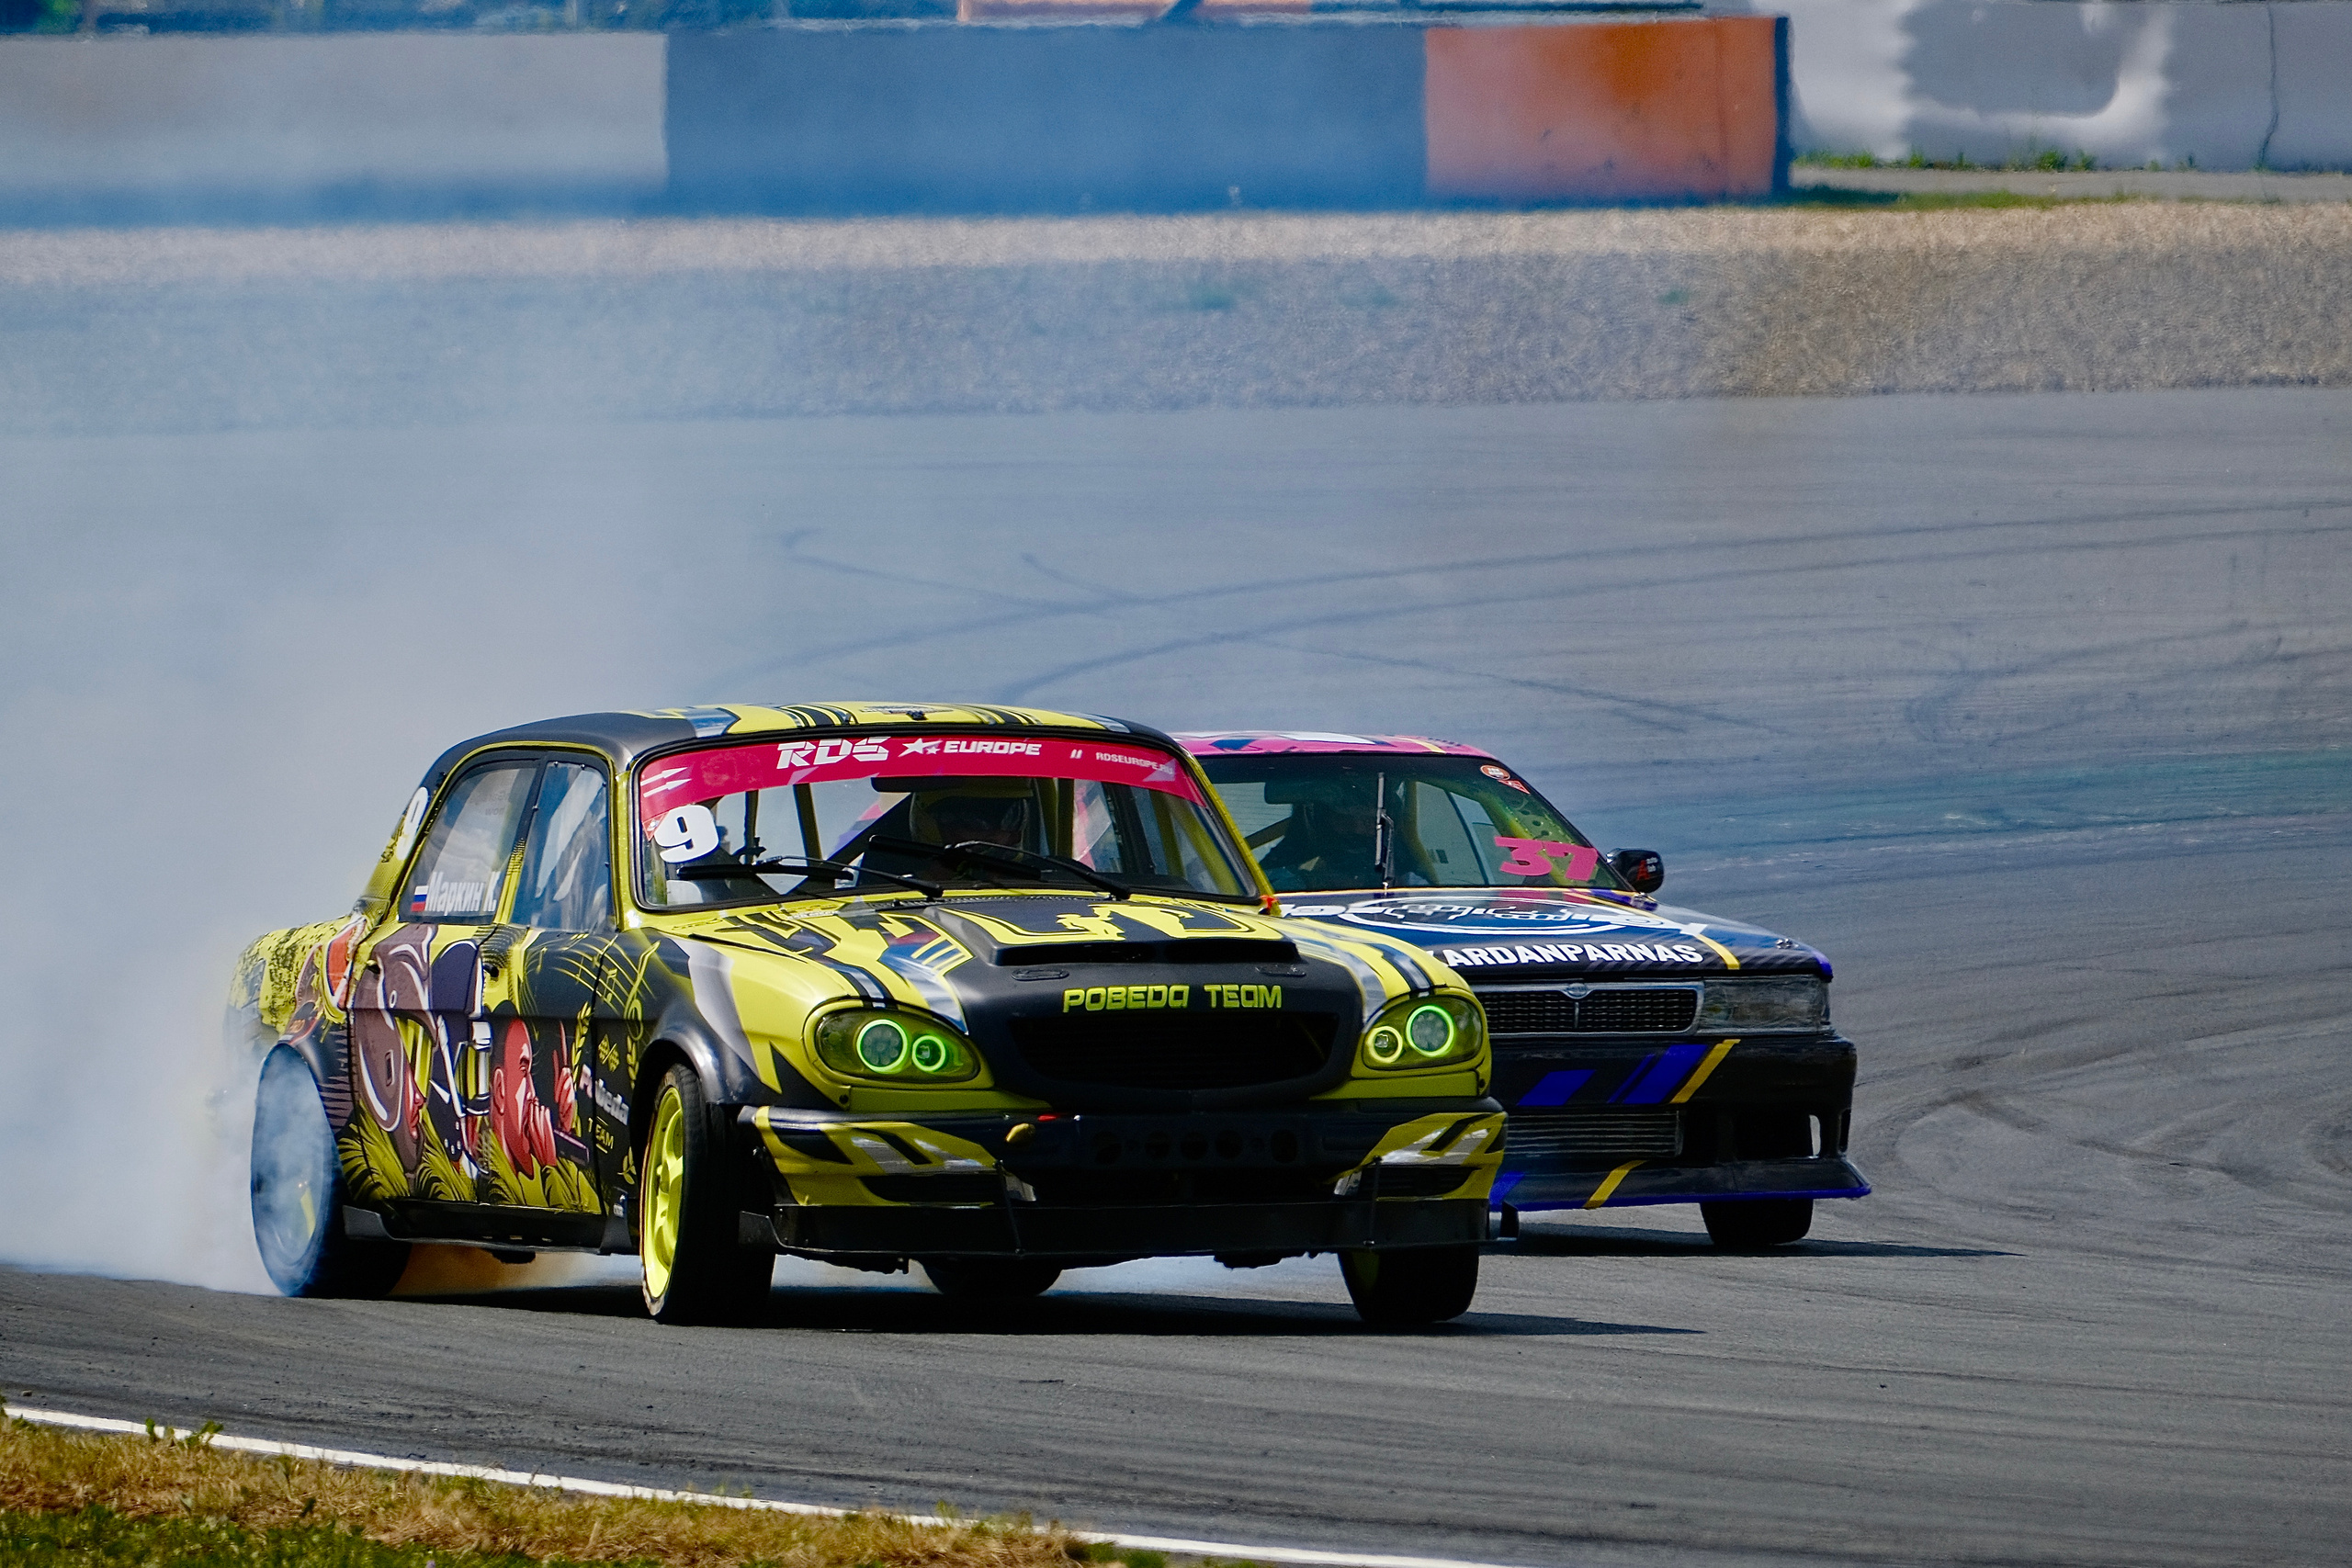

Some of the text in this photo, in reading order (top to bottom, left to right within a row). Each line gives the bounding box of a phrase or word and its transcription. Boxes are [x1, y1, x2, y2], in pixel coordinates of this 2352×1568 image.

[776, 736, 1042, 769] RDS EUROPE
[654, 805, 718, 863] 9
[1494, 836, 1599, 882] 37
[424, 872, 485, 916] Маркин
[1425, 944, 1703, 967] ARDANPARNAS
[1063, 985, 1283, 1012] POBEDA TEAM
